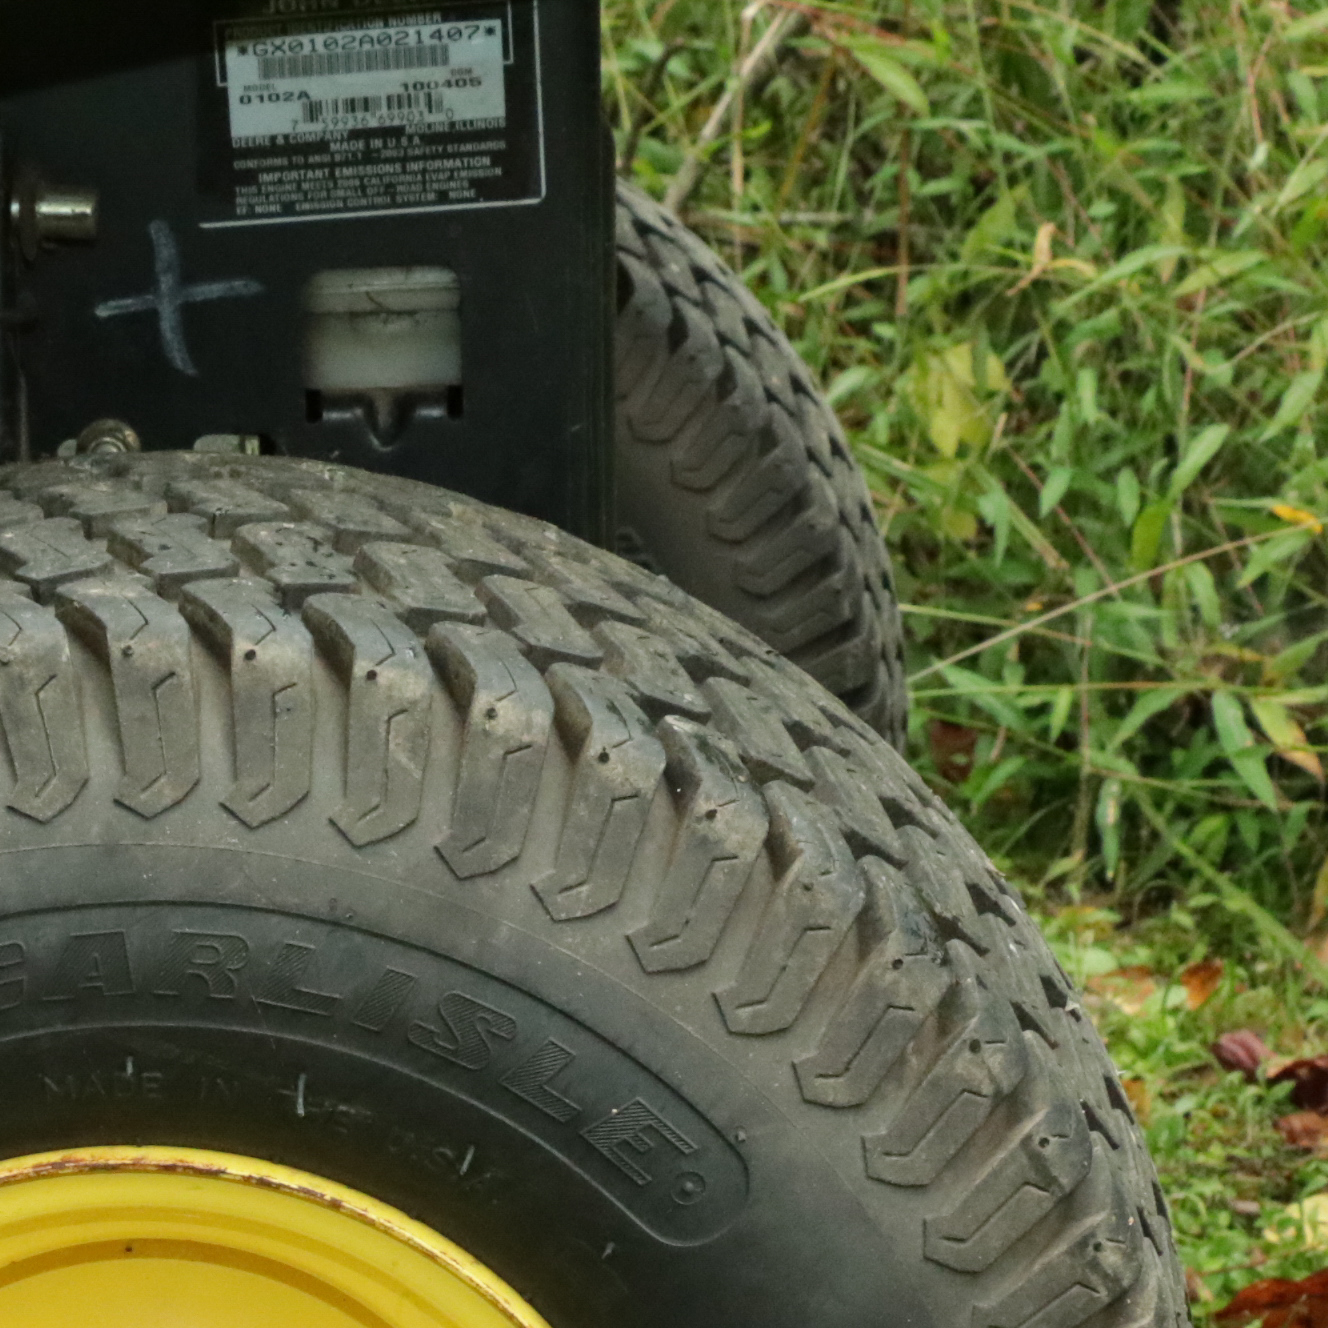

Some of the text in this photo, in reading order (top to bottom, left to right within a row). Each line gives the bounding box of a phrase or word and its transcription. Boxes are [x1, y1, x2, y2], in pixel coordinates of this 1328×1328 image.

[388, 10, 442, 27] NUMBER
[239, 90, 311, 105] 0102A
[456, 118, 506, 131] ILLINOIS
[275, 133, 285, 146] &
[289, 130, 349, 144] COMPANY
[329, 139, 365, 152] MADE
[370, 138, 383, 149] IN
[233, 156, 289, 169] CONFORMS
[292, 155, 304, 165] TO
[307, 154, 331, 164] ANSI
[407, 145, 444, 156] SAFETY
[447, 140, 506, 153] STANDARDS
[258, 155, 491, 183] IMPORTANT EMISSIONS INFORMATION
[261, 182, 298, 194] ENGINE
[363, 173, 422, 186] CALIFORNIA
